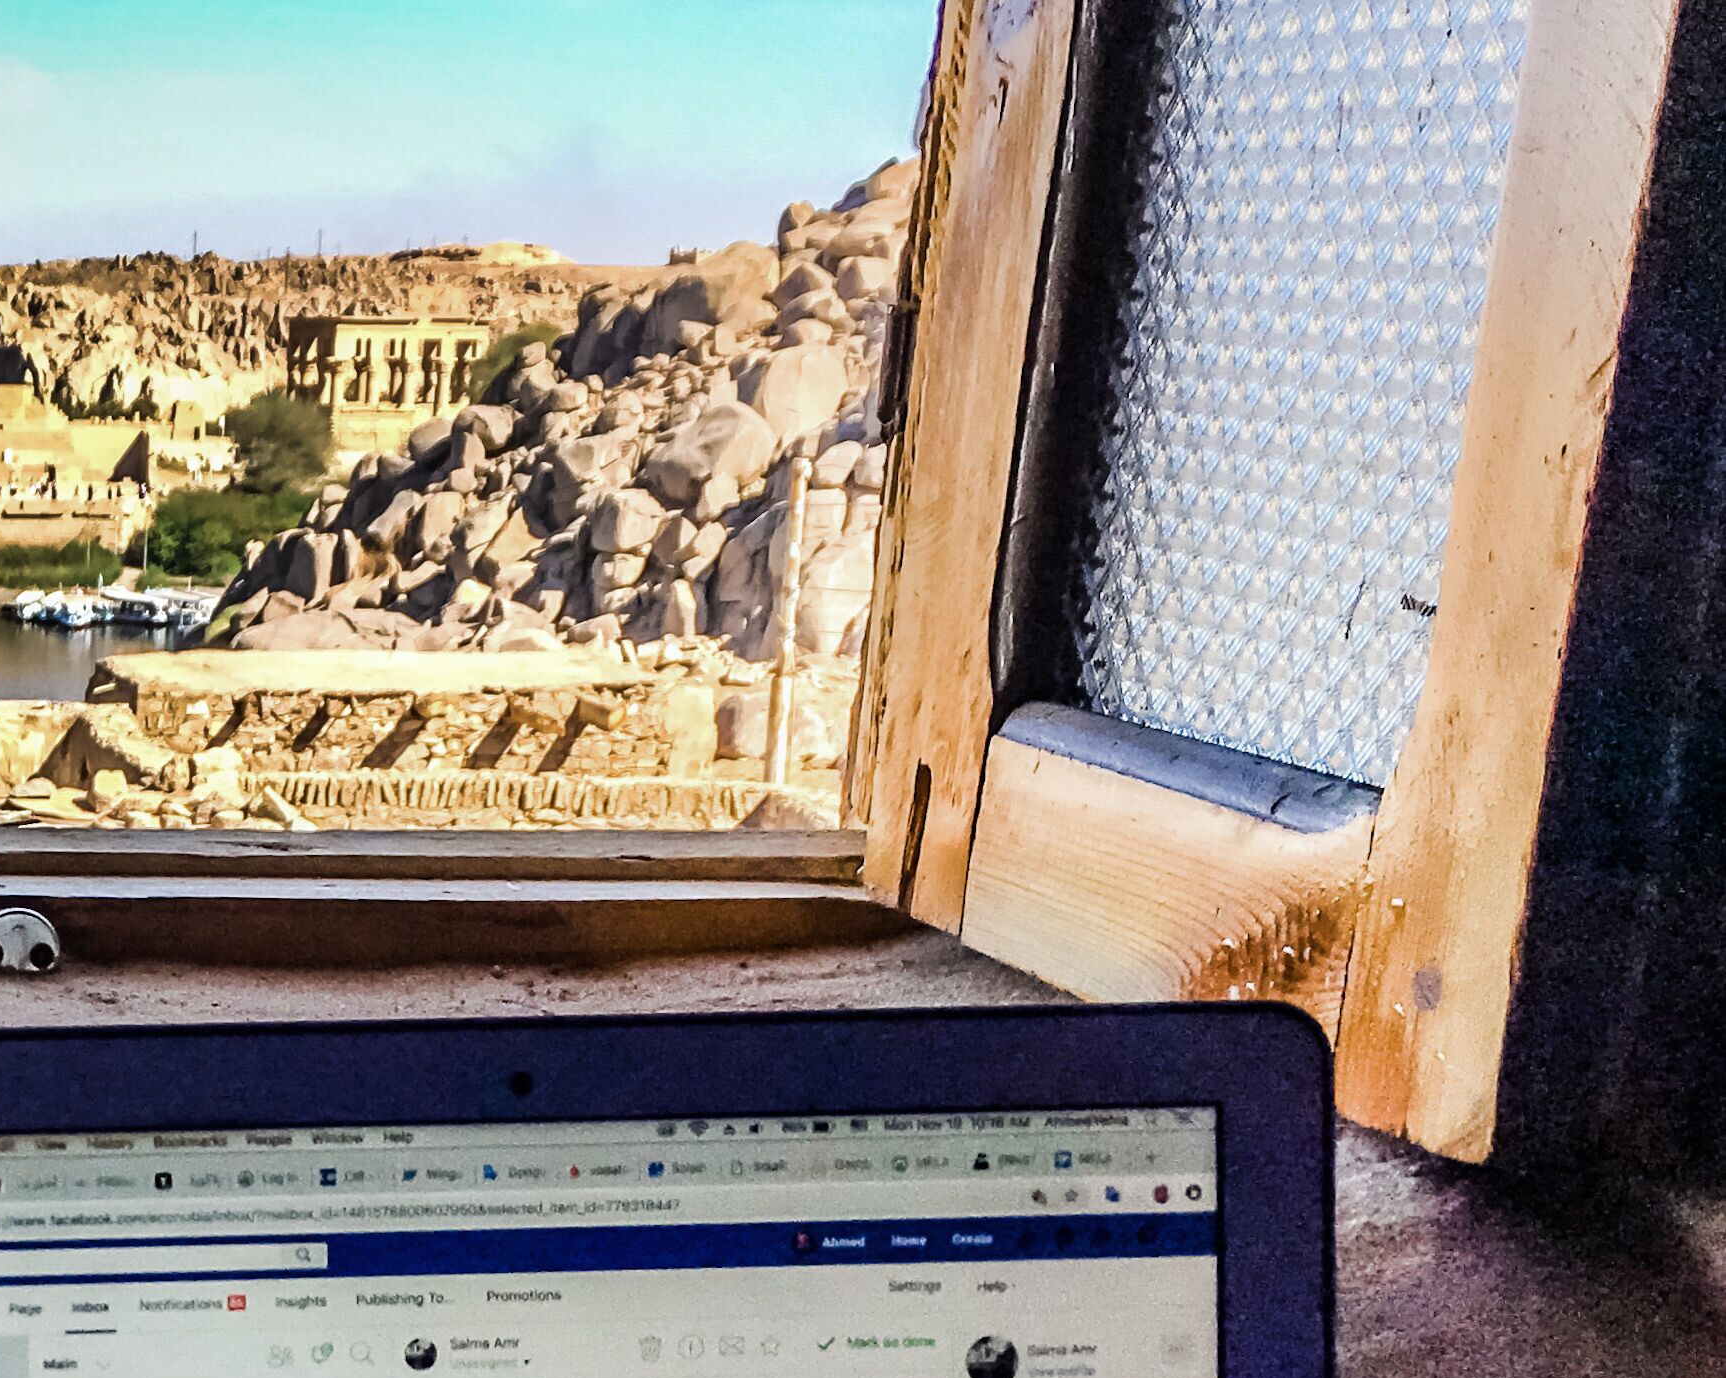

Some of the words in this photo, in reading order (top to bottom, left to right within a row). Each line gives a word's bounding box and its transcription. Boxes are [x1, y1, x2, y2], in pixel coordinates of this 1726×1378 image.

[154, 1134, 228, 1148] Bookmarks
[246, 1133, 293, 1147] People
[312, 1131, 364, 1145] Window
[383, 1129, 413, 1145] Help
[822, 1236, 866, 1248] Ahmed
[891, 1234, 927, 1246] Home
[888, 1281, 942, 1294] Settings
[977, 1280, 1008, 1293] Help
[356, 1293, 425, 1307] Publishing
[485, 1289, 562, 1302] Promotions
[9, 1303, 42, 1316] Page
[72, 1301, 110, 1313] Inbox
[139, 1298, 224, 1312] Notifications
[275, 1296, 327, 1310] Insights
[449, 1337, 490, 1350] Salma
[494, 1336, 521, 1349] Amr
